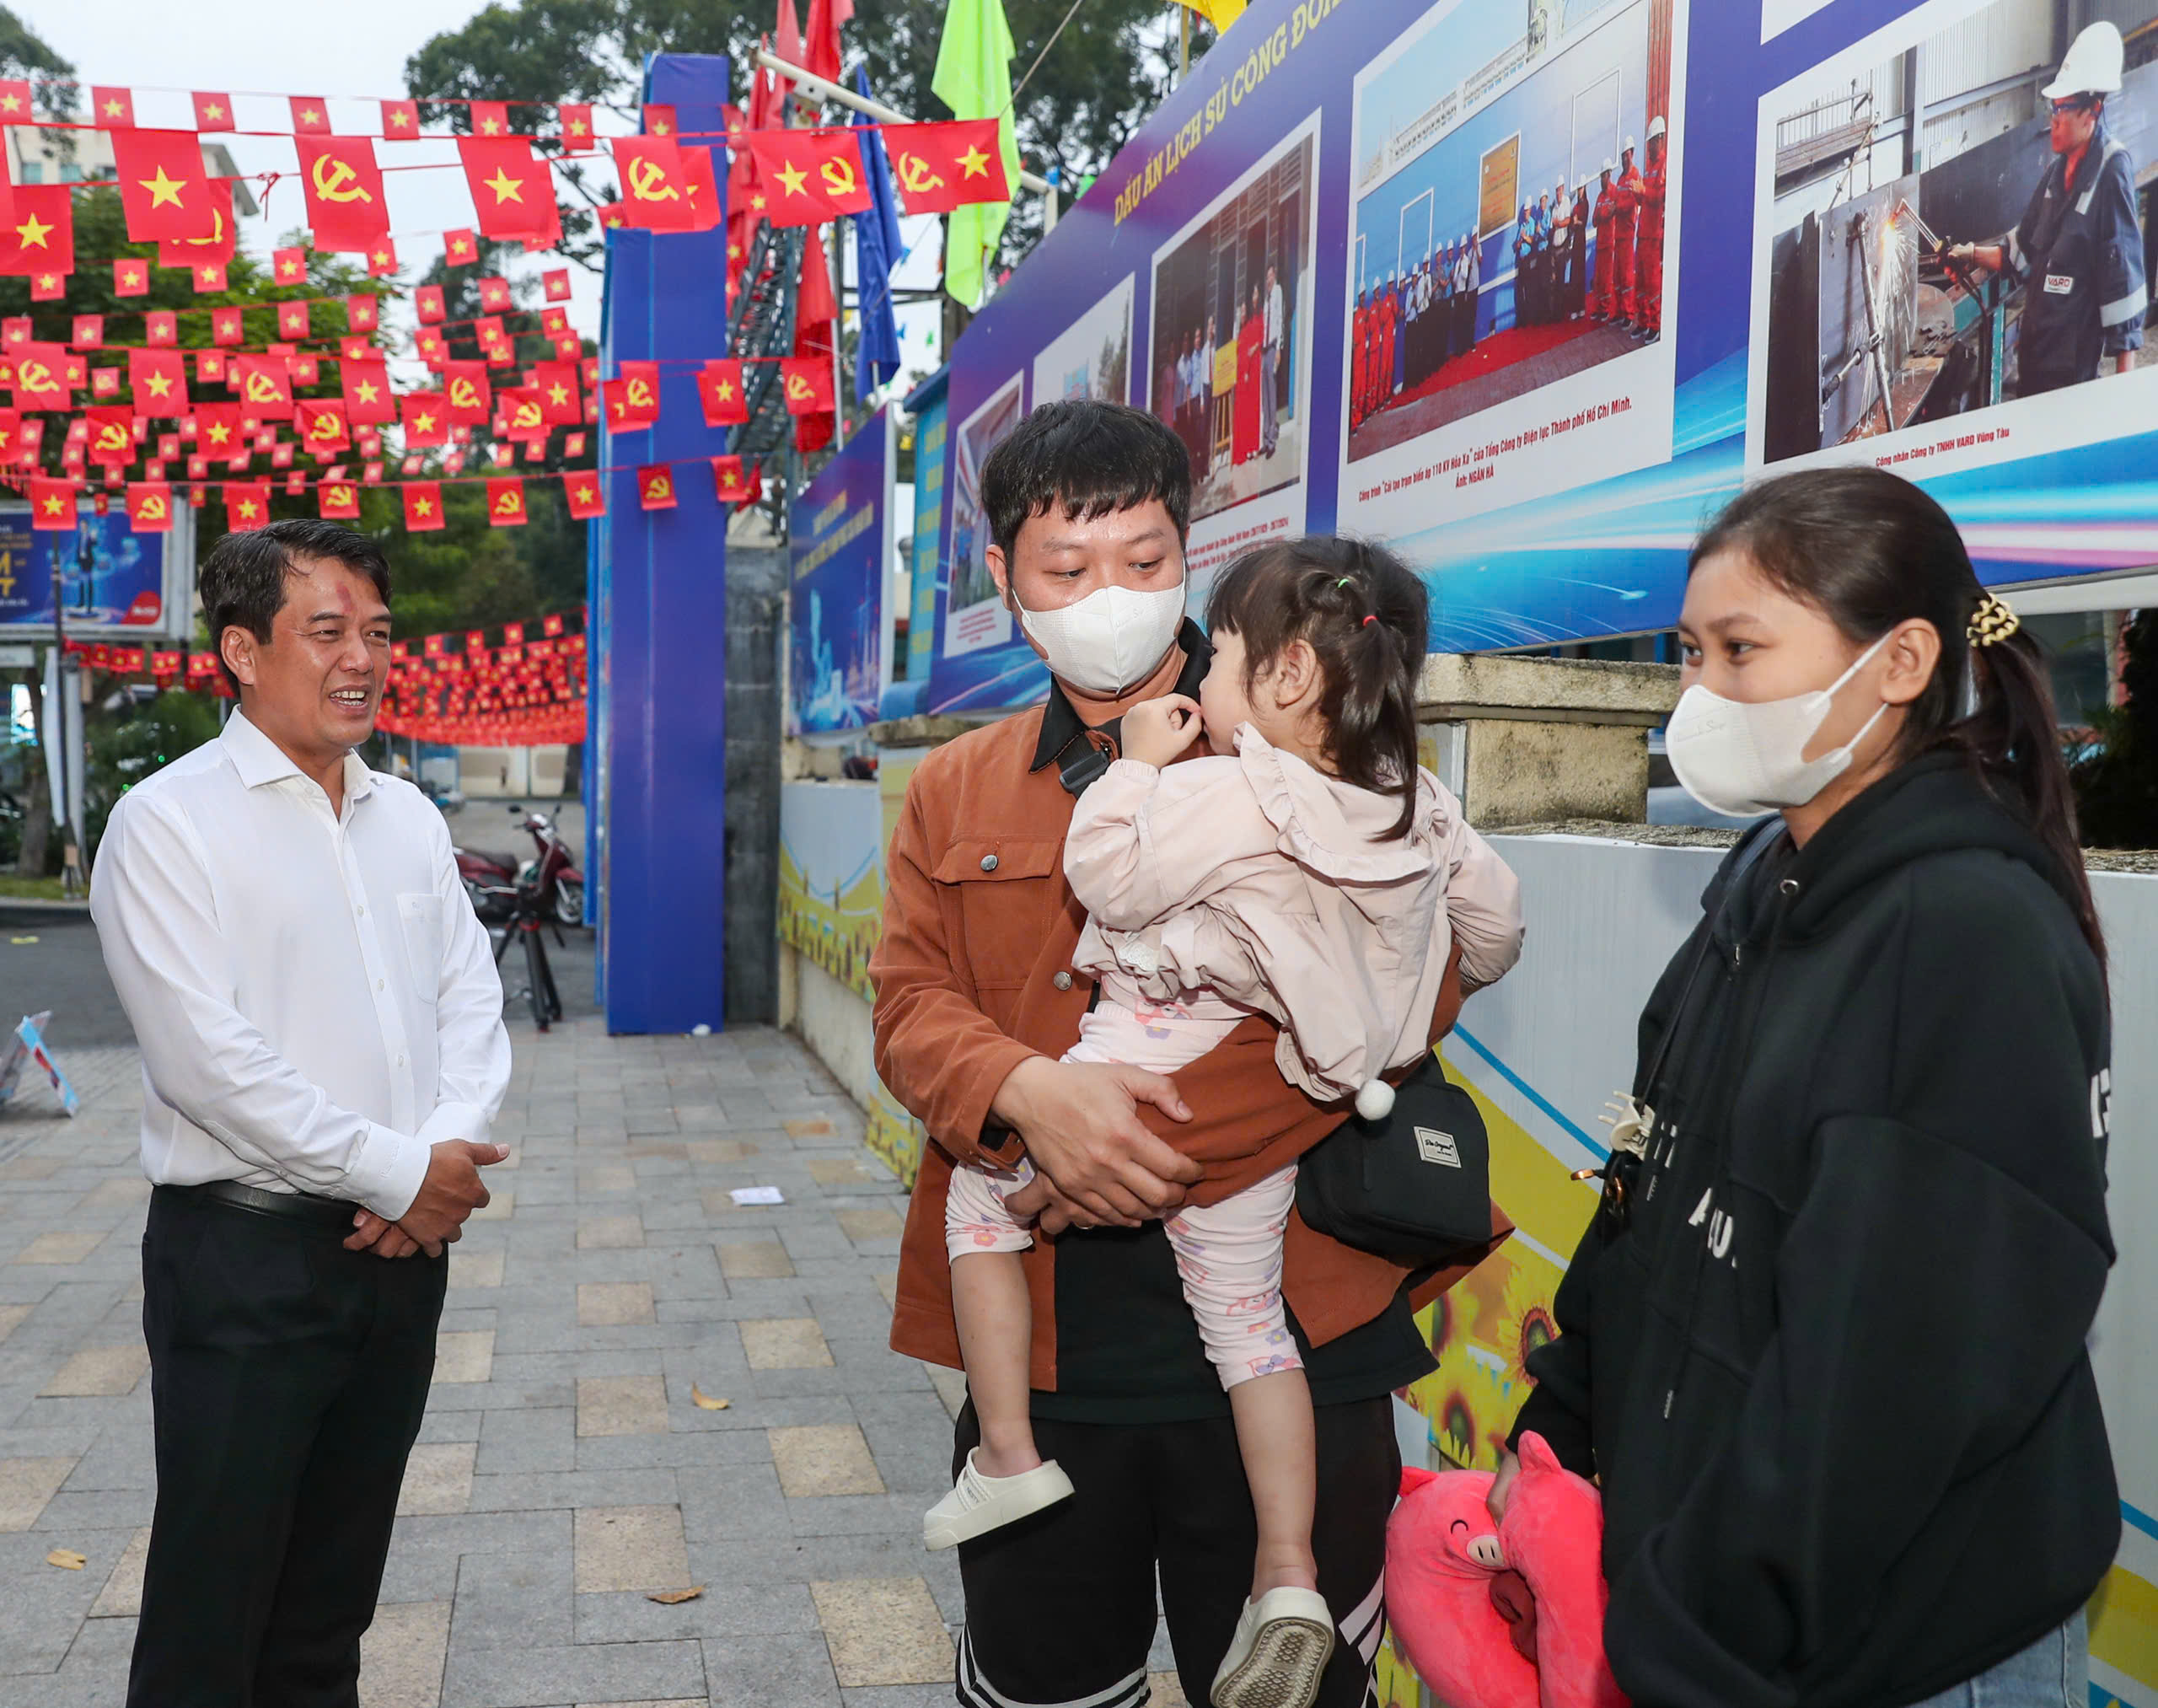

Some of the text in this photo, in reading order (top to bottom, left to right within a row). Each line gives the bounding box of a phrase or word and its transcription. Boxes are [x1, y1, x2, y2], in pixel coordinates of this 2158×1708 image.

[1165, 110, 1202, 175] LỊCH
[1231, 21, 1287, 107] CÔNG
[1432, 463, 1442, 476] 110
[1538, 426, 1550, 442] lực
[1550, 417, 1570, 436] Thành
[1571, 408, 1586, 431] phố
[1611, 396, 1633, 416] Minh.
[1876, 427, 2010, 468] Công nhân Công ty TNHH VARD Vũng Tàu
